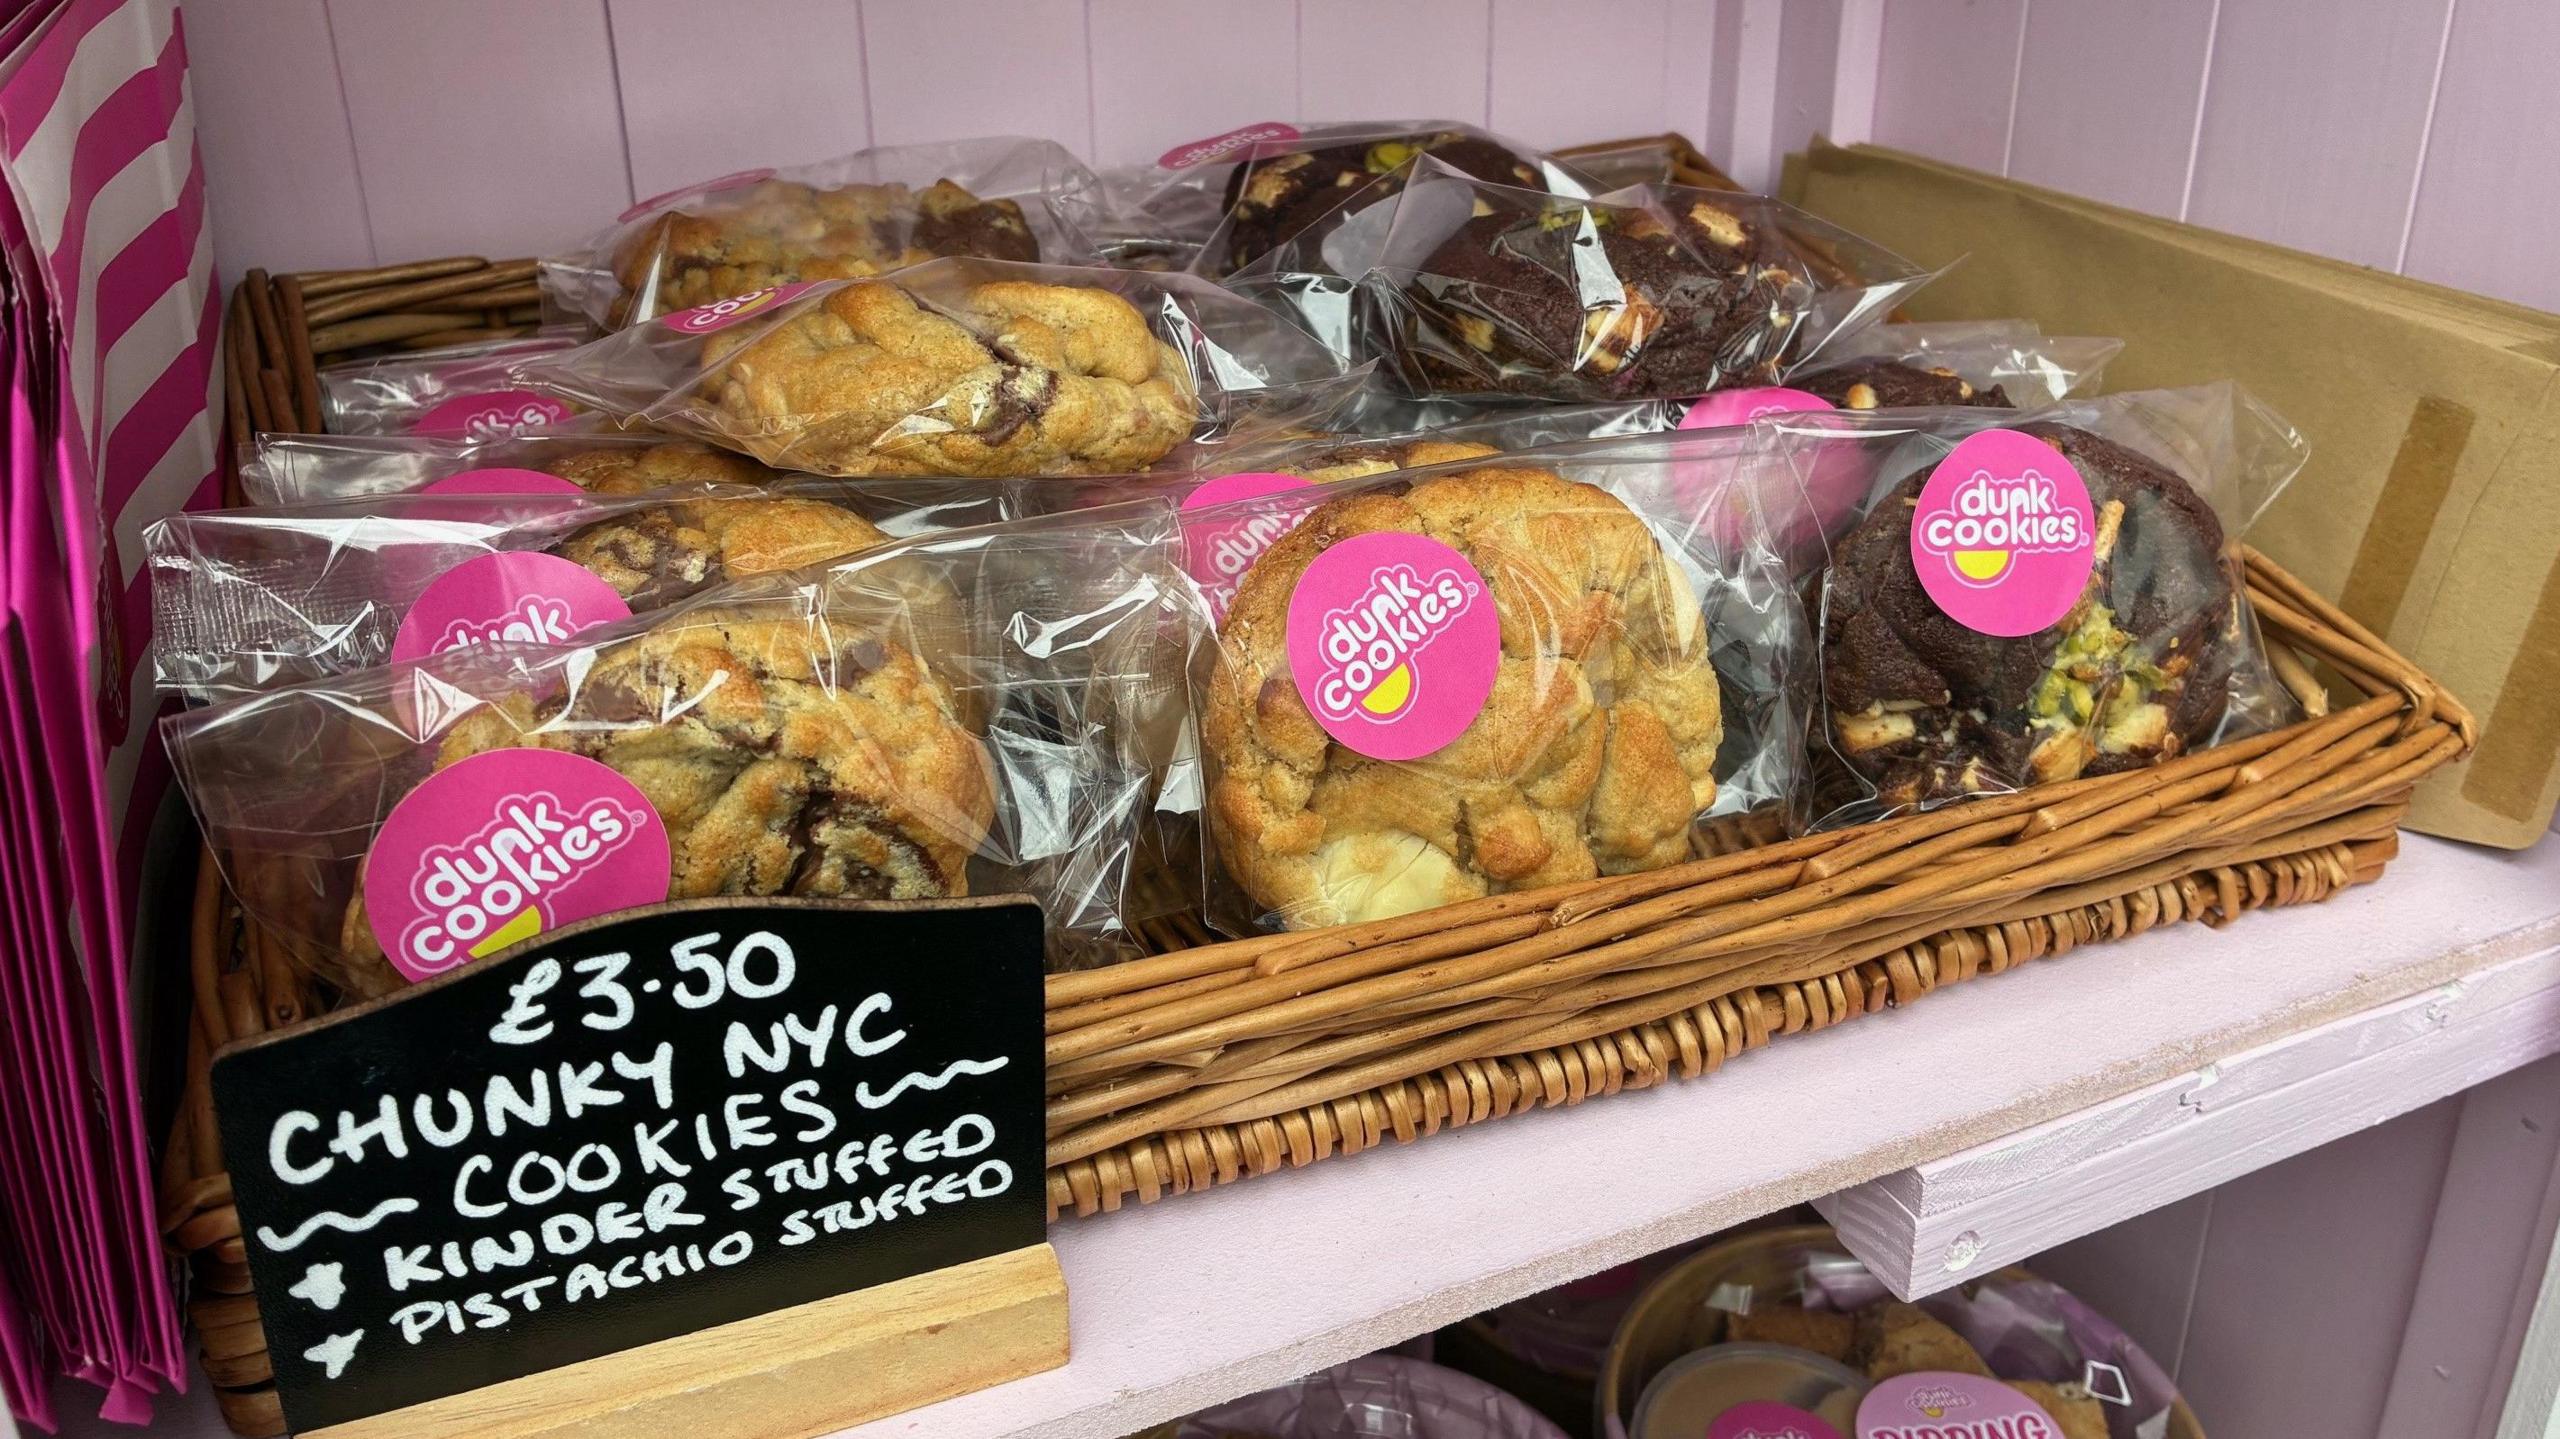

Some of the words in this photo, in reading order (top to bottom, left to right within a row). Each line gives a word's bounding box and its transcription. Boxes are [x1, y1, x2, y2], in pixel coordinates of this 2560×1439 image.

[1926, 511, 2077, 546] cookies
[1960, 478, 2052, 516] dunk
[1323, 578, 1463, 711] cookies
[1328, 572, 1422, 663] dunk
[412, 807, 623, 962] cookies
[423, 802, 565, 907] dunk
[268, 1041, 674, 1185] CHUNKY
[723, 992, 907, 1078] NYC
[453, 1078, 838, 1218] COOKIES
[383, 1182, 706, 1292] KINDER
[721, 1113, 996, 1211] STUFFED
[389, 1230, 754, 1345] PISTACHIO
[778, 1159, 1013, 1246] STUFFED
